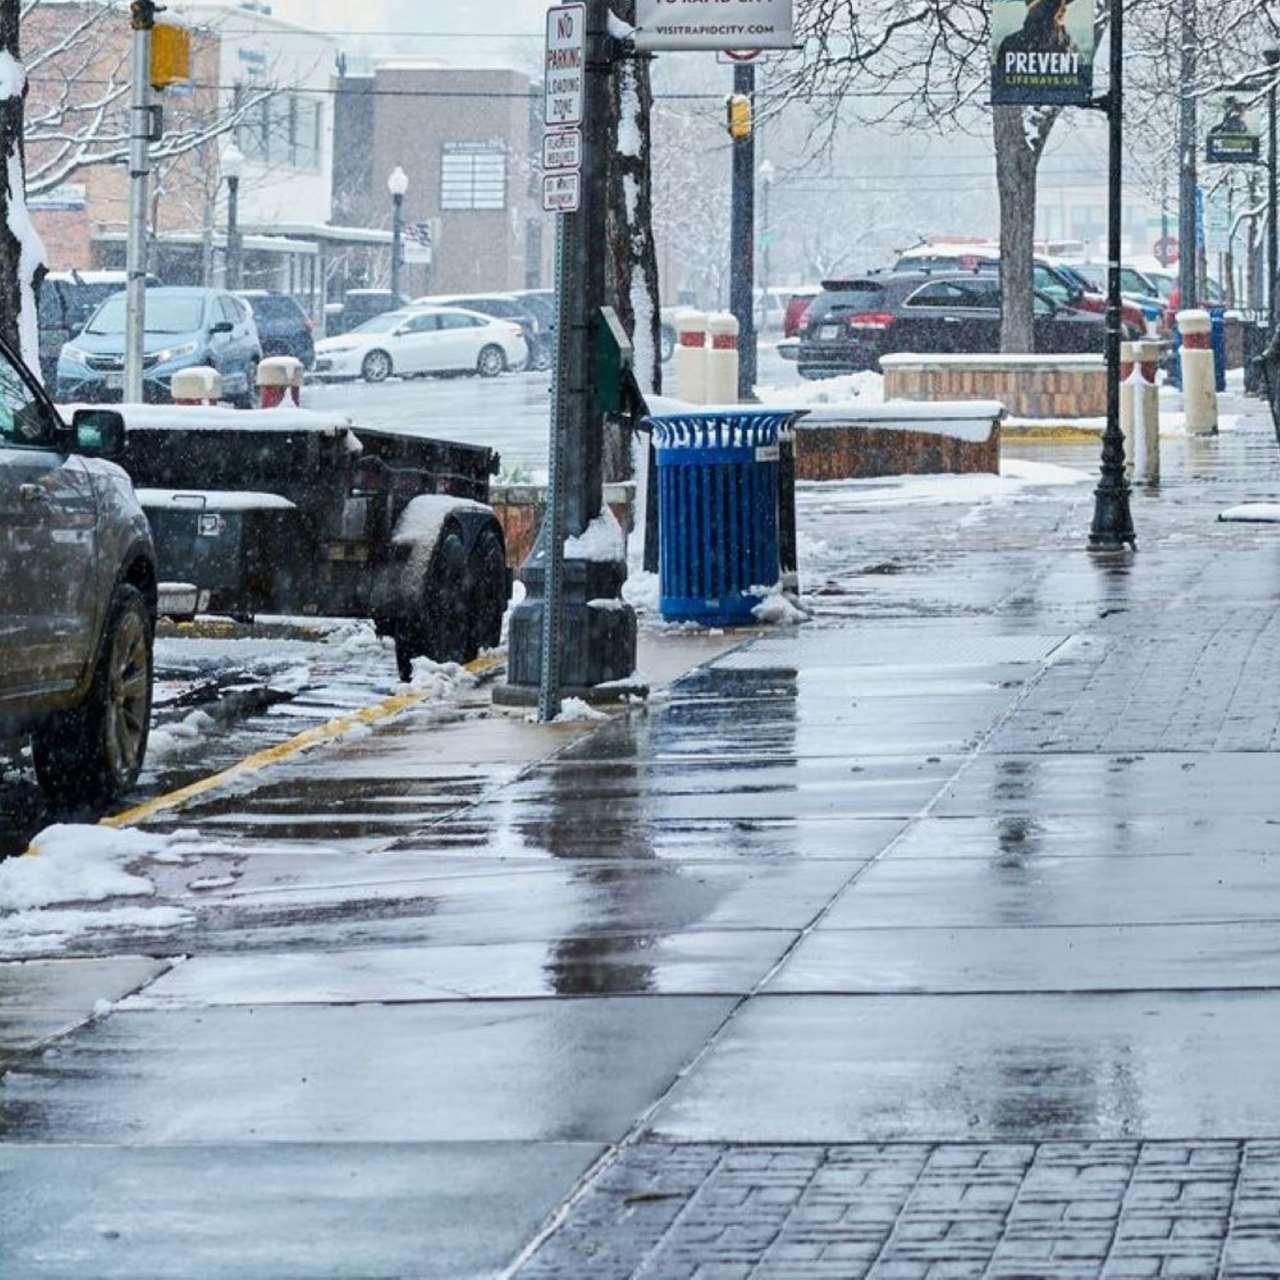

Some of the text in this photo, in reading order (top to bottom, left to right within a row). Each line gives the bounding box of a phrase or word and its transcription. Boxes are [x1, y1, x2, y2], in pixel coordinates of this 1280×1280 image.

[557, 16, 574, 40] NO
[656, 25, 775, 35] VISITRAPIDCITY.COM
[547, 46, 581, 71] PARKING
[1005, 51, 1079, 74] PREVENT
